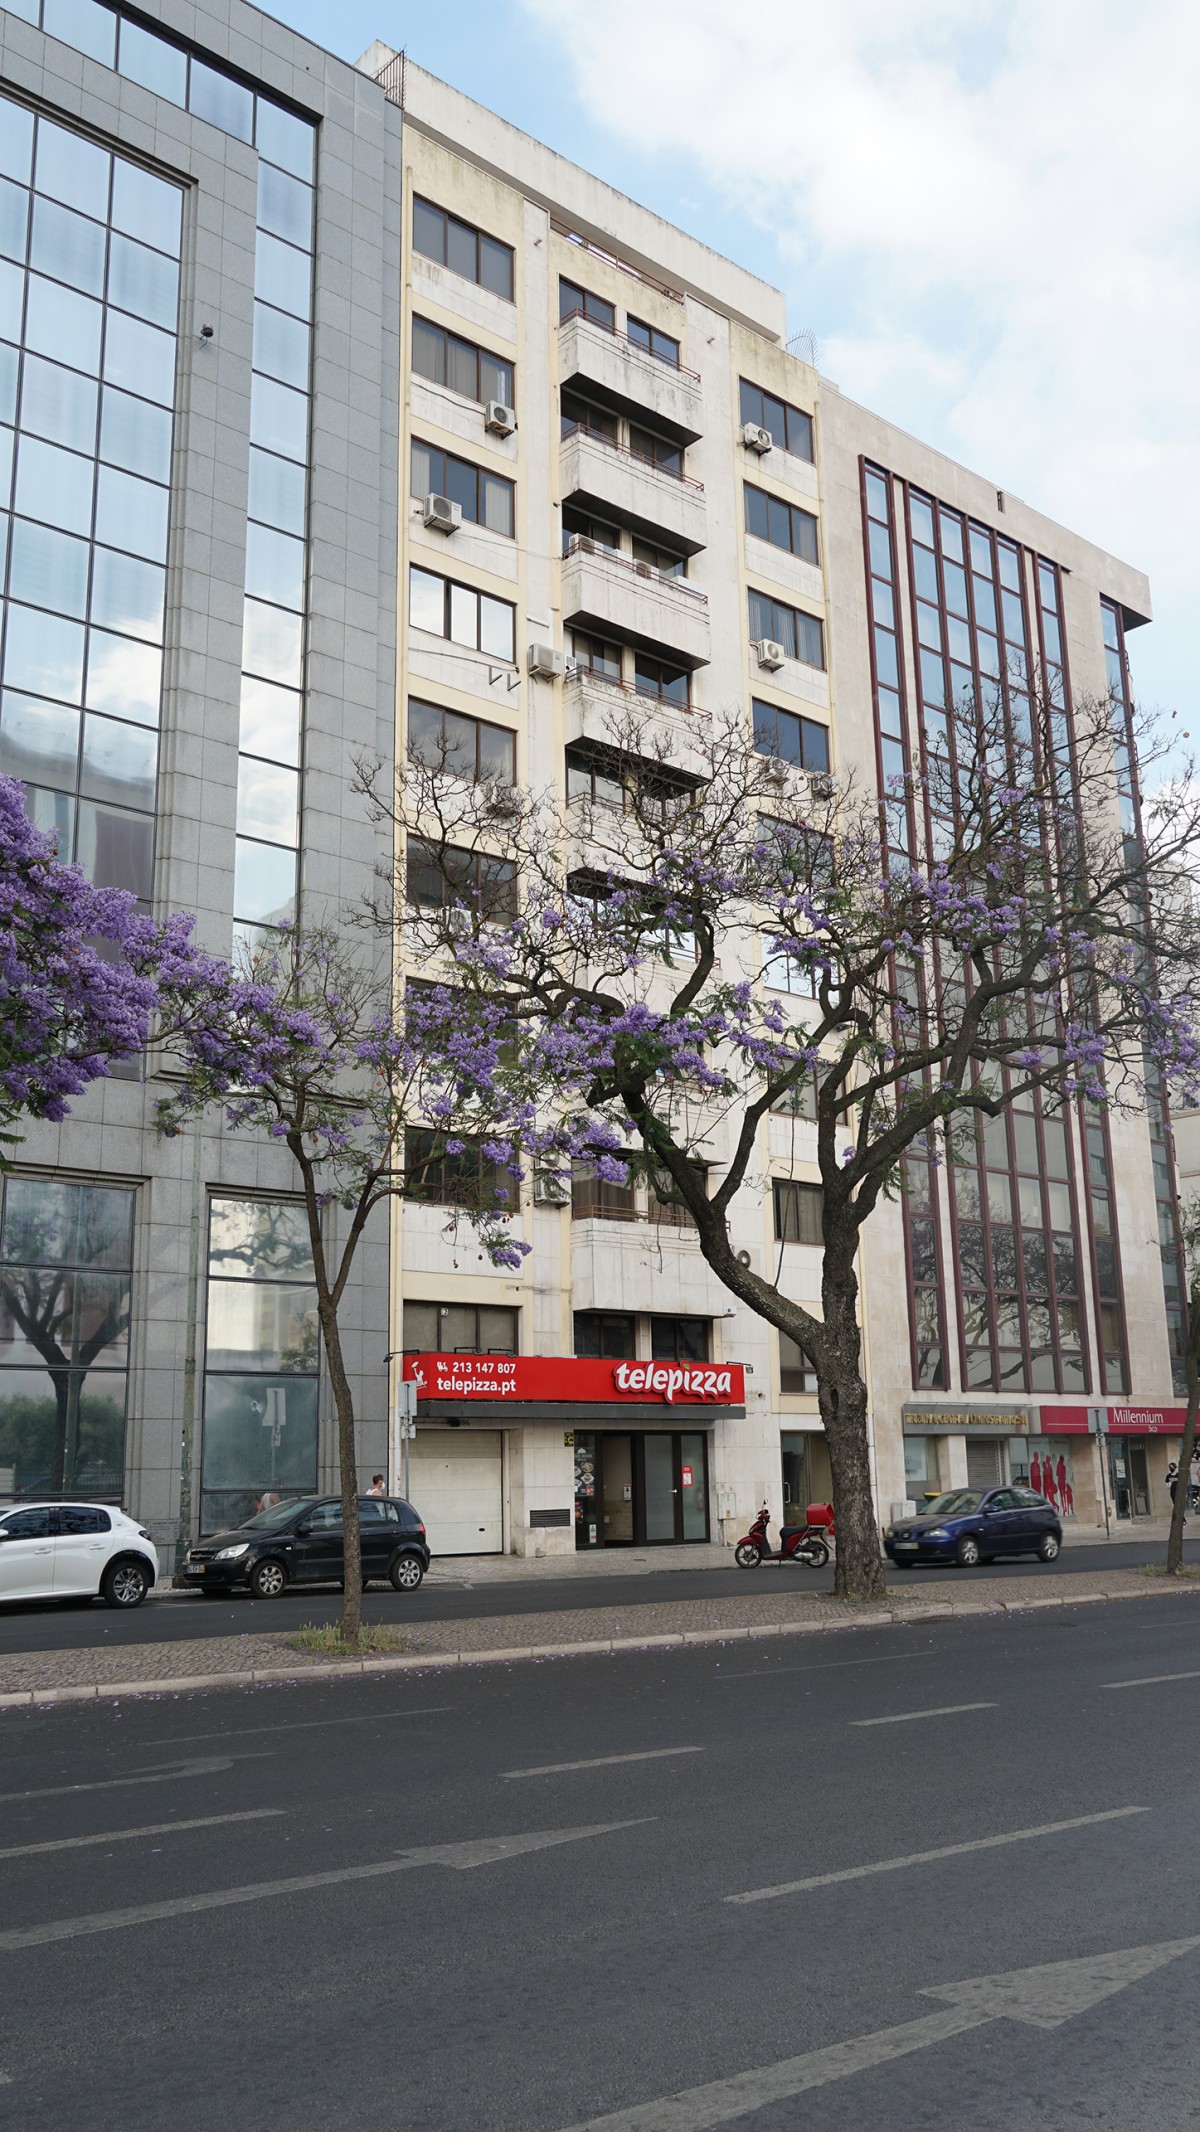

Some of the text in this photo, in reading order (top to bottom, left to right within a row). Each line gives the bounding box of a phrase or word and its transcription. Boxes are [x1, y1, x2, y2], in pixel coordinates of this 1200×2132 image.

[453, 1362, 516, 1374] 213 147 807
[437, 1375, 516, 1396] telepizza.pt
[616, 1362, 732, 1401] telepizza
[1113, 1407, 1164, 1424] Millennium
